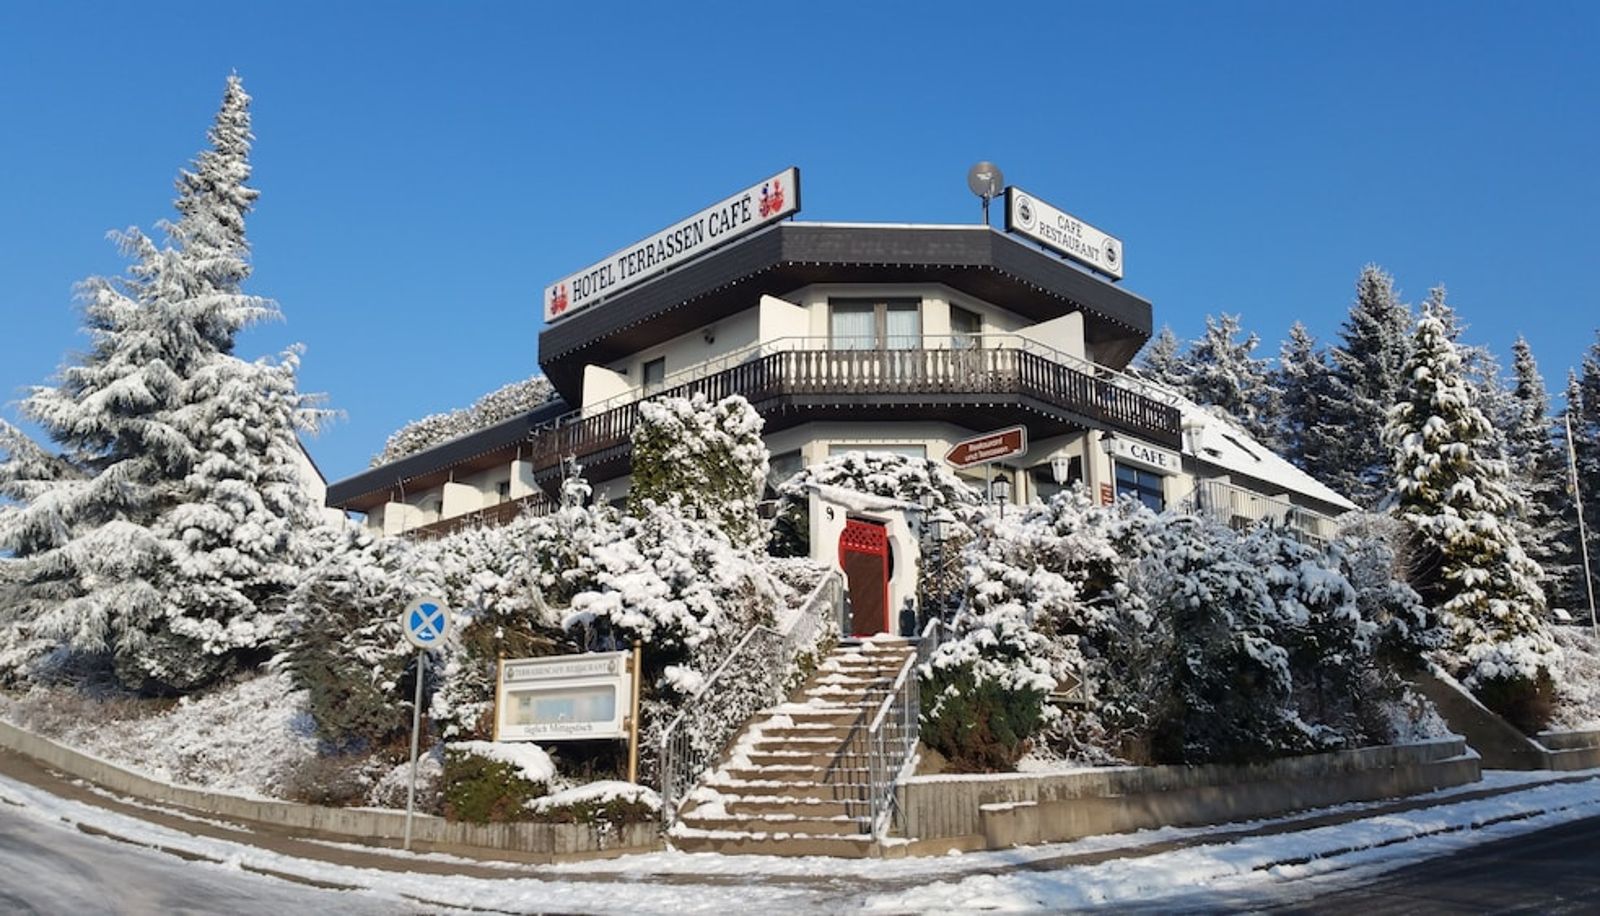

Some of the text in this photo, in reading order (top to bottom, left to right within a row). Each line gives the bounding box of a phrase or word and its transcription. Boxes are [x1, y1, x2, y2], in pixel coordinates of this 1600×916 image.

[572, 193, 752, 302] HOTEL TERRASSEN CAFÉ
[1039, 221, 1100, 261] RESTAURANT
[1131, 445, 1167, 467] CAFE
[826, 506, 835, 520] 9
